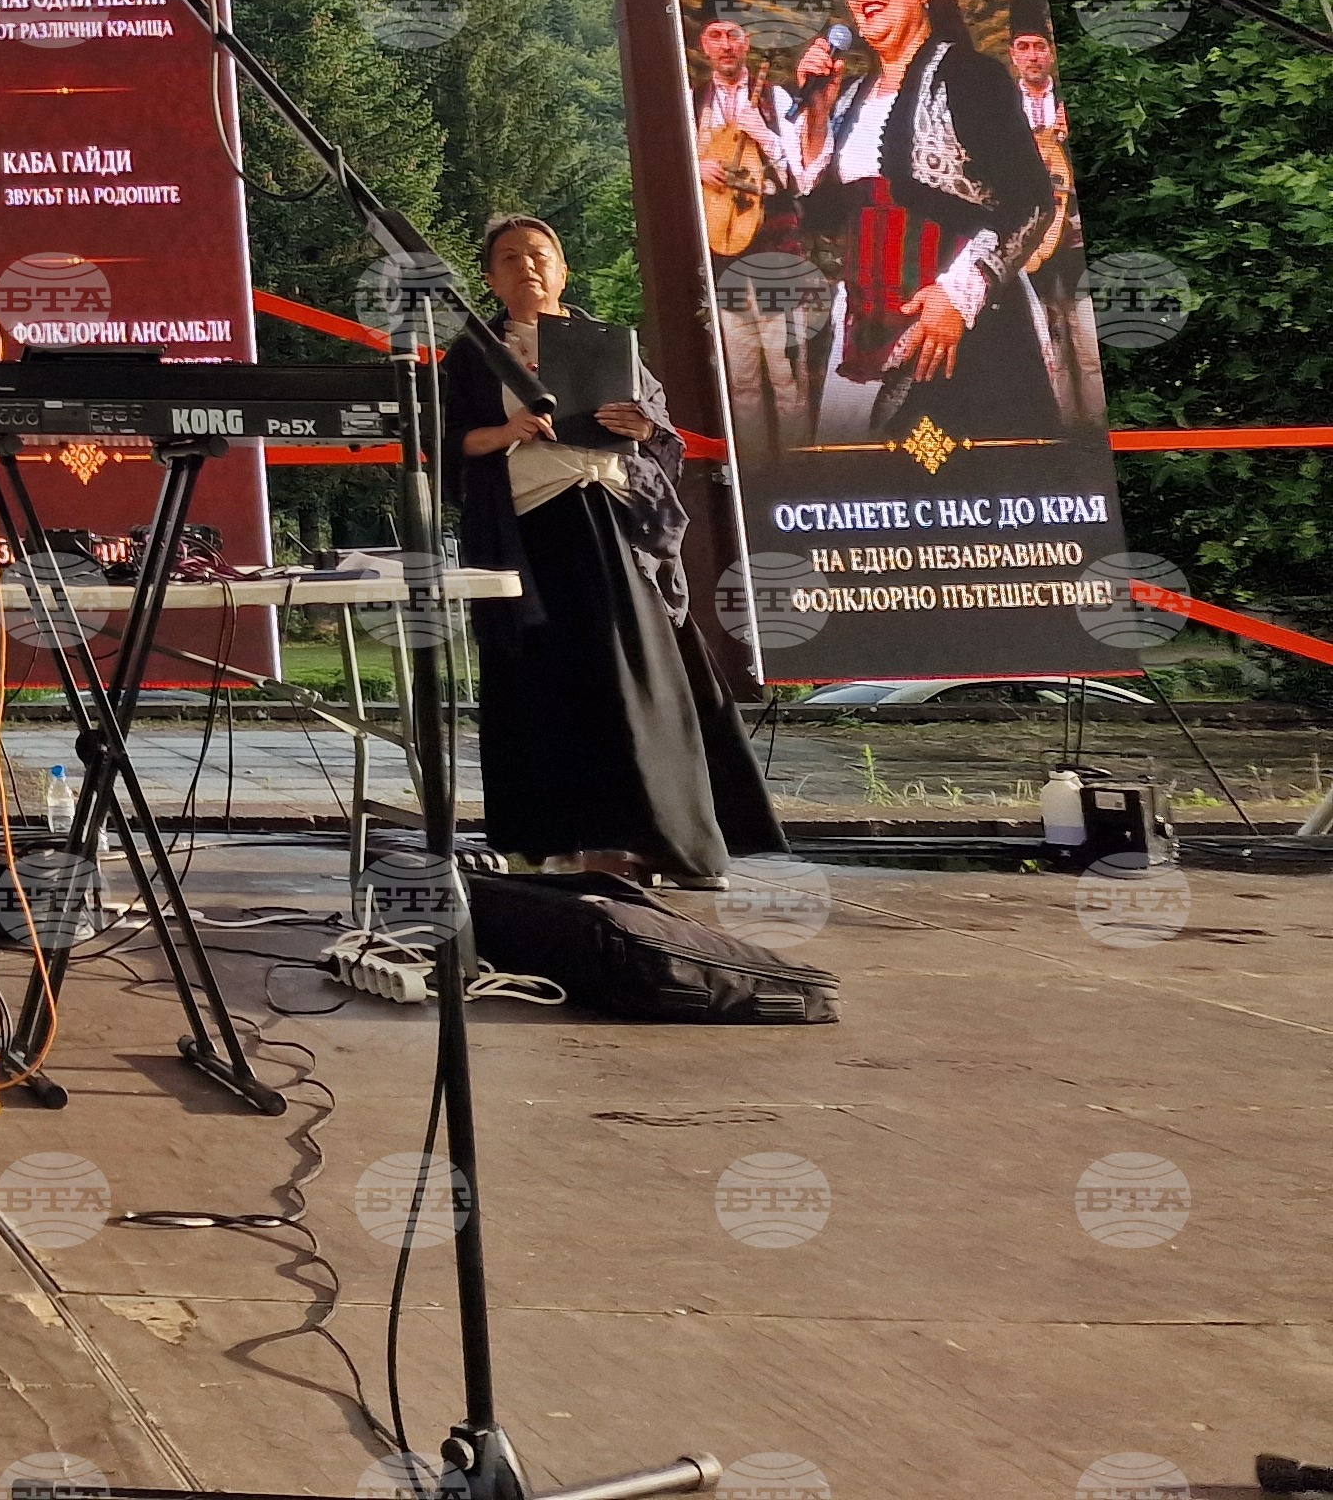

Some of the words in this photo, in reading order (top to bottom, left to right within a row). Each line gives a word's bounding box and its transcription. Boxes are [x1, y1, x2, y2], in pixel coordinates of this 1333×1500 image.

[20, 21, 104, 40] РАЗЛИЧНИ
[2, 151, 58, 174] КАБА
[61, 145, 133, 177] ГАЙДИ
[4, 187, 64, 206] ЗВУКЪТ
[67, 187, 91, 205] НА
[94, 185, 181, 206] РОДОПИТЕ
[12, 321, 127, 346] ФОЛКЛОРНИ
[131, 320, 232, 343] АНСАМБЛИ
[171, 408, 244, 435] KORG
[267, 418, 317, 436] Pa5X
[774, 500, 911, 532] ОСТАНЕТЕ
[915, 499, 933, 530] С
[939, 498, 992, 528] НАС
[997, 496, 1036, 530] ДО
[1041, 494, 1109, 525] КРАЯ
[810, 548, 846, 574] НА
[849, 546, 913, 576] ЕДНО
[917, 540, 1084, 571] НЕЗАБРАВИМО
[791, 584, 937, 614] ФОЛКЛОРНО
[941, 579, 1114, 611] ПЪТЕШЕСТВИЕ!
